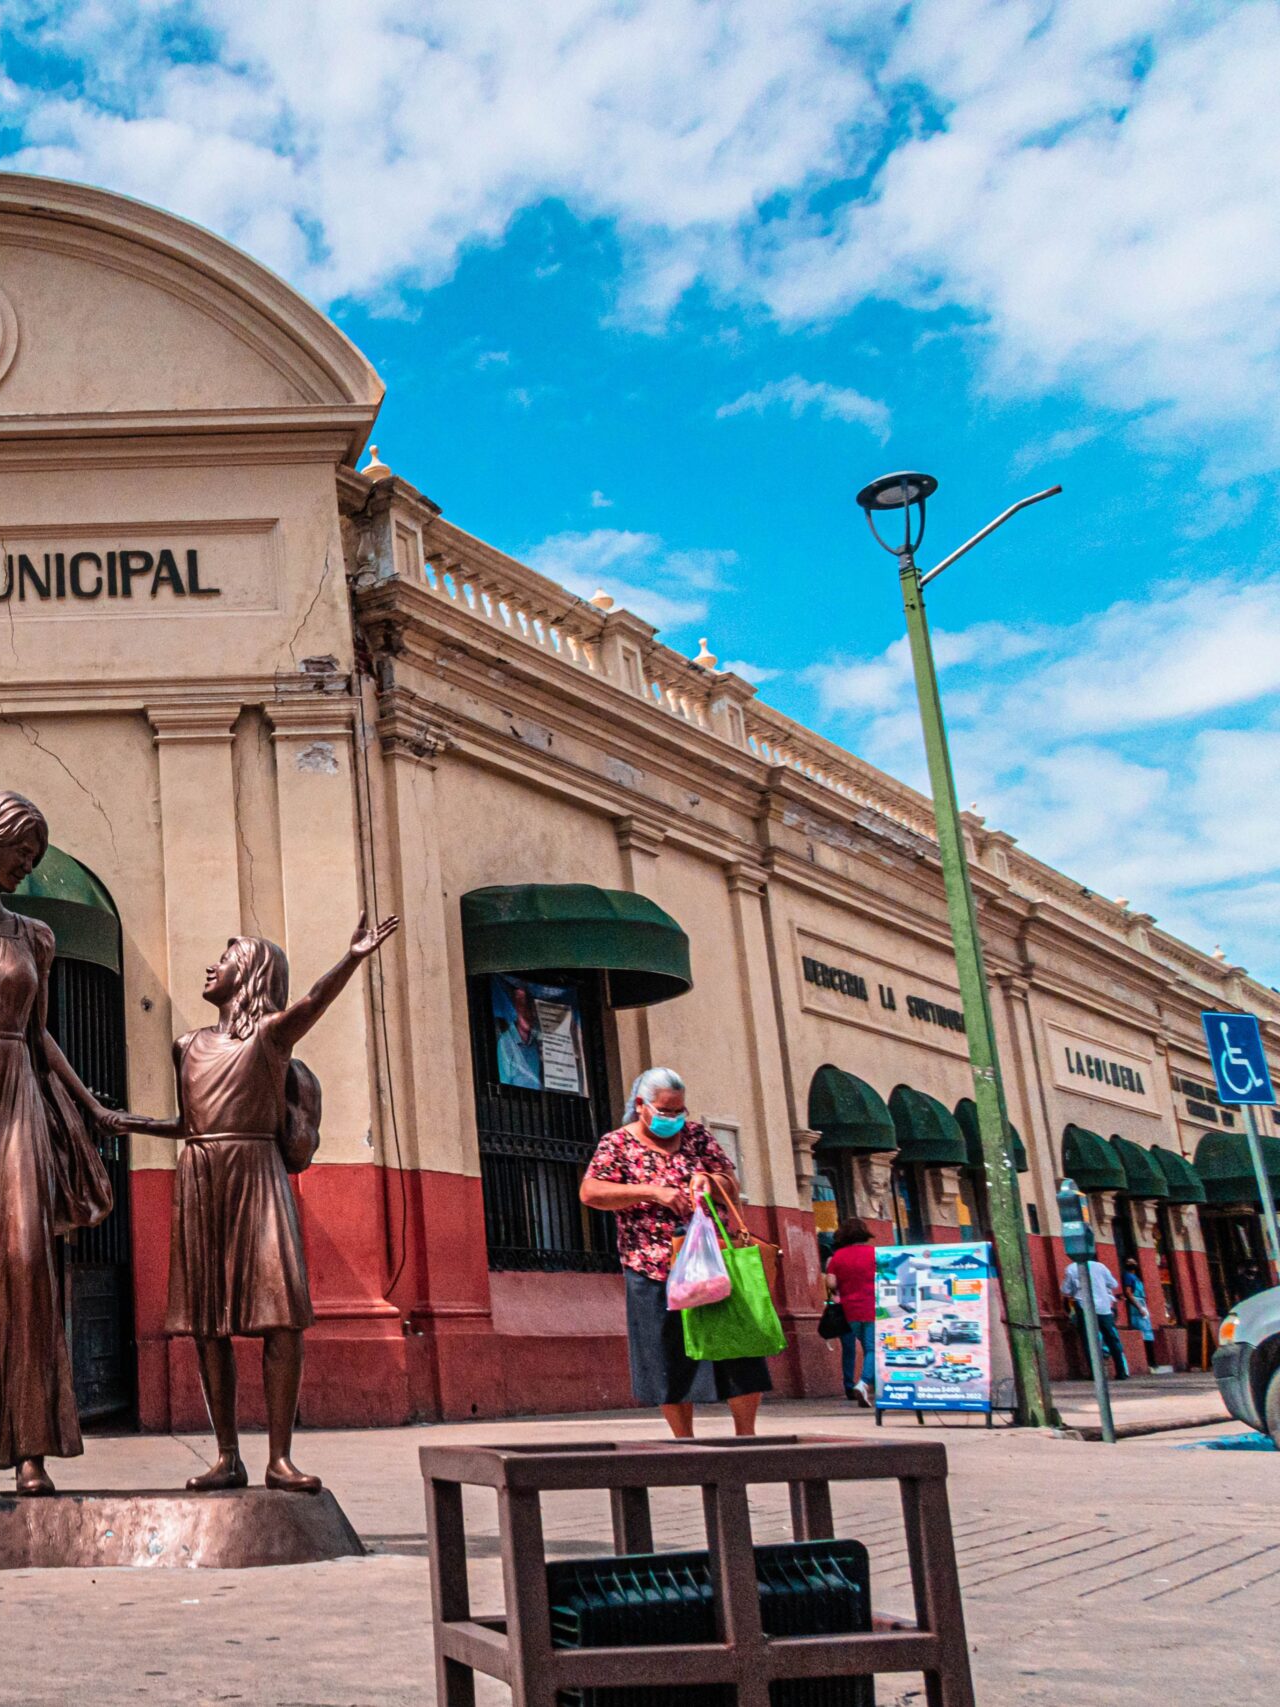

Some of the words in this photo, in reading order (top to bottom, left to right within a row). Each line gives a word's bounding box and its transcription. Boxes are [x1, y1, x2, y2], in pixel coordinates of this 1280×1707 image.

[802, 955, 869, 1002] MERCERIA
[878, 983, 897, 1011] LA
[1065, 1047, 1086, 1077] LA
[1085, 1054, 1145, 1096] COLMENA
